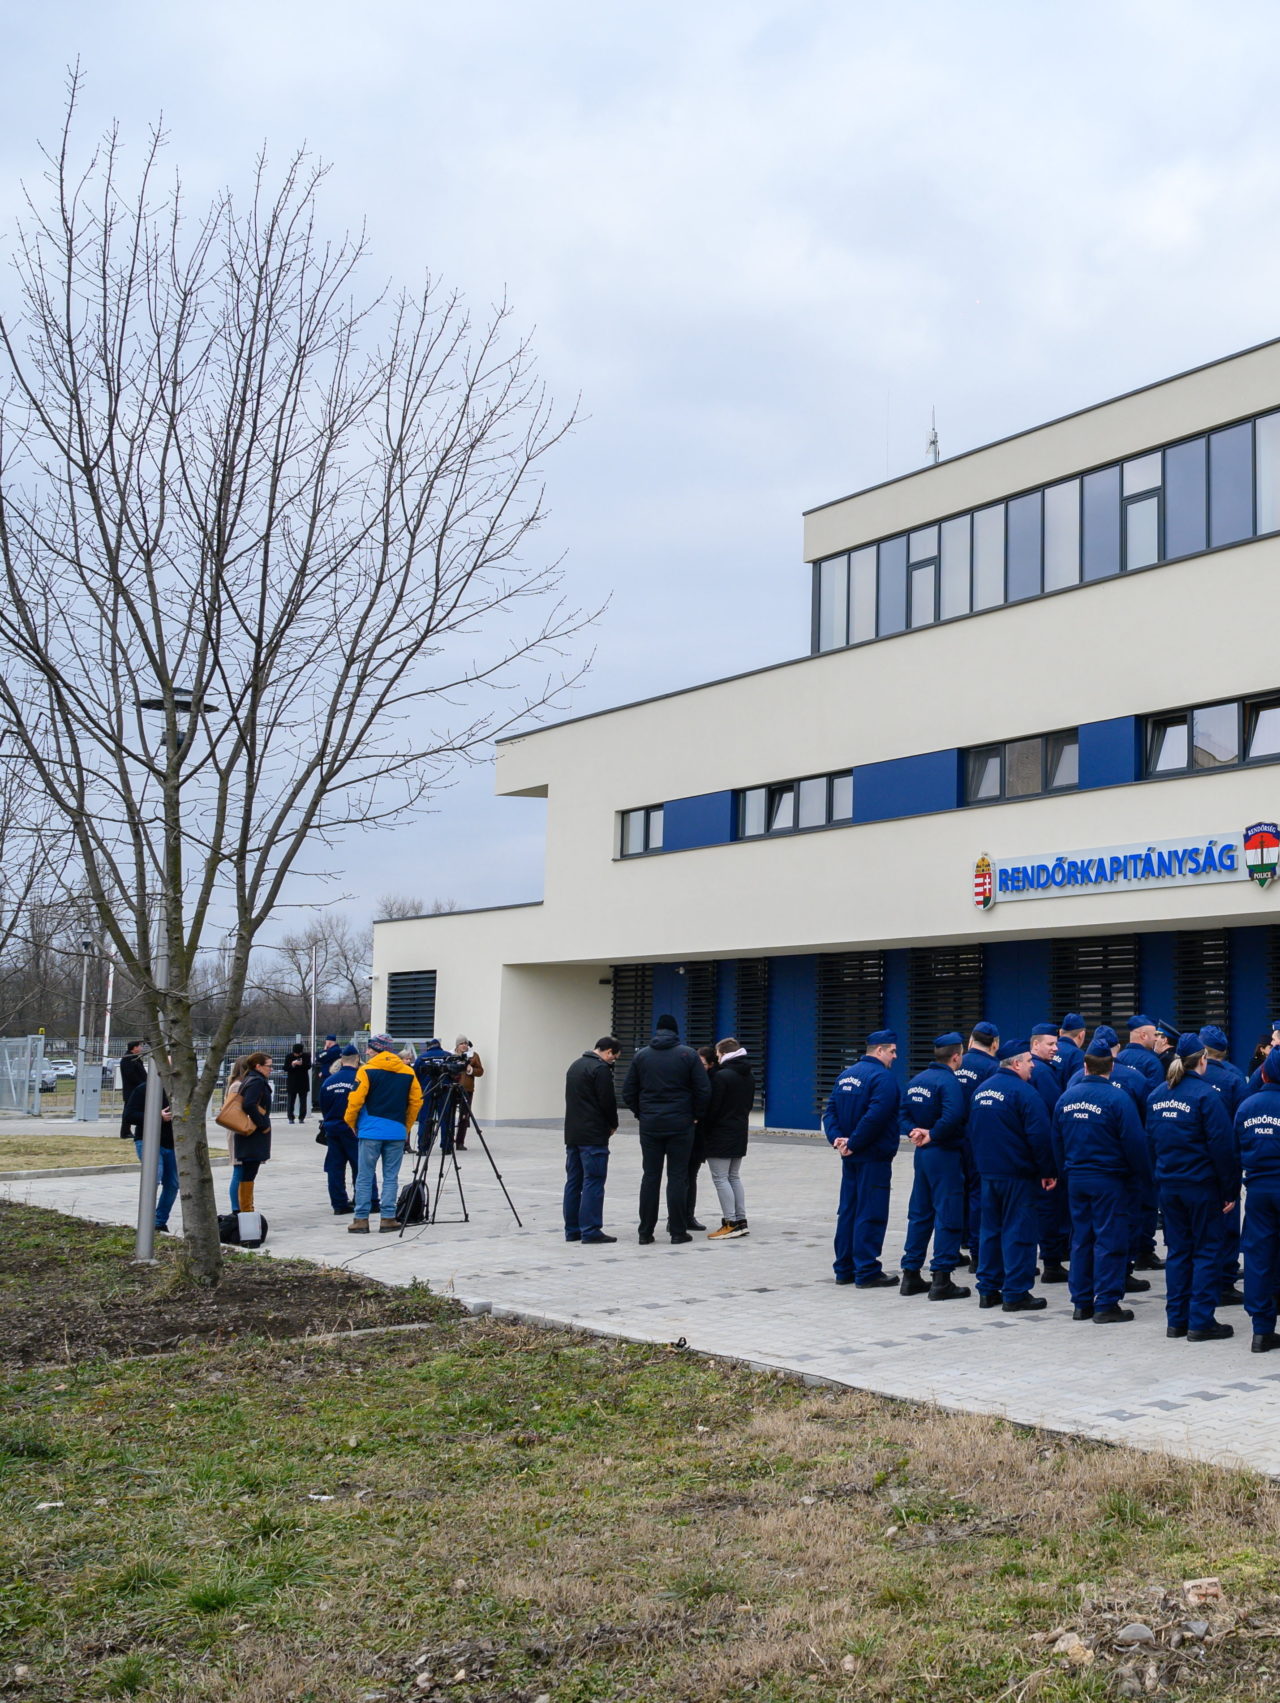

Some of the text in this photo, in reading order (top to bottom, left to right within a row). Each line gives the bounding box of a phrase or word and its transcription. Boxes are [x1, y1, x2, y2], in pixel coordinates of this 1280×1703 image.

[998, 840, 1236, 891] RENDŐRKAPITÁNYSÁG
[1254, 871, 1272, 879] POLICE
[907, 1086, 931, 1098] RENDŐRSÉG
[974, 1089, 1005, 1102] RENDŐRSÉG
[1063, 1101, 1102, 1115] RENDŐRSÉG
[1152, 1099, 1191, 1113] RENDŐRSÉG
[1254, 1127, 1274, 1135] POLICE
